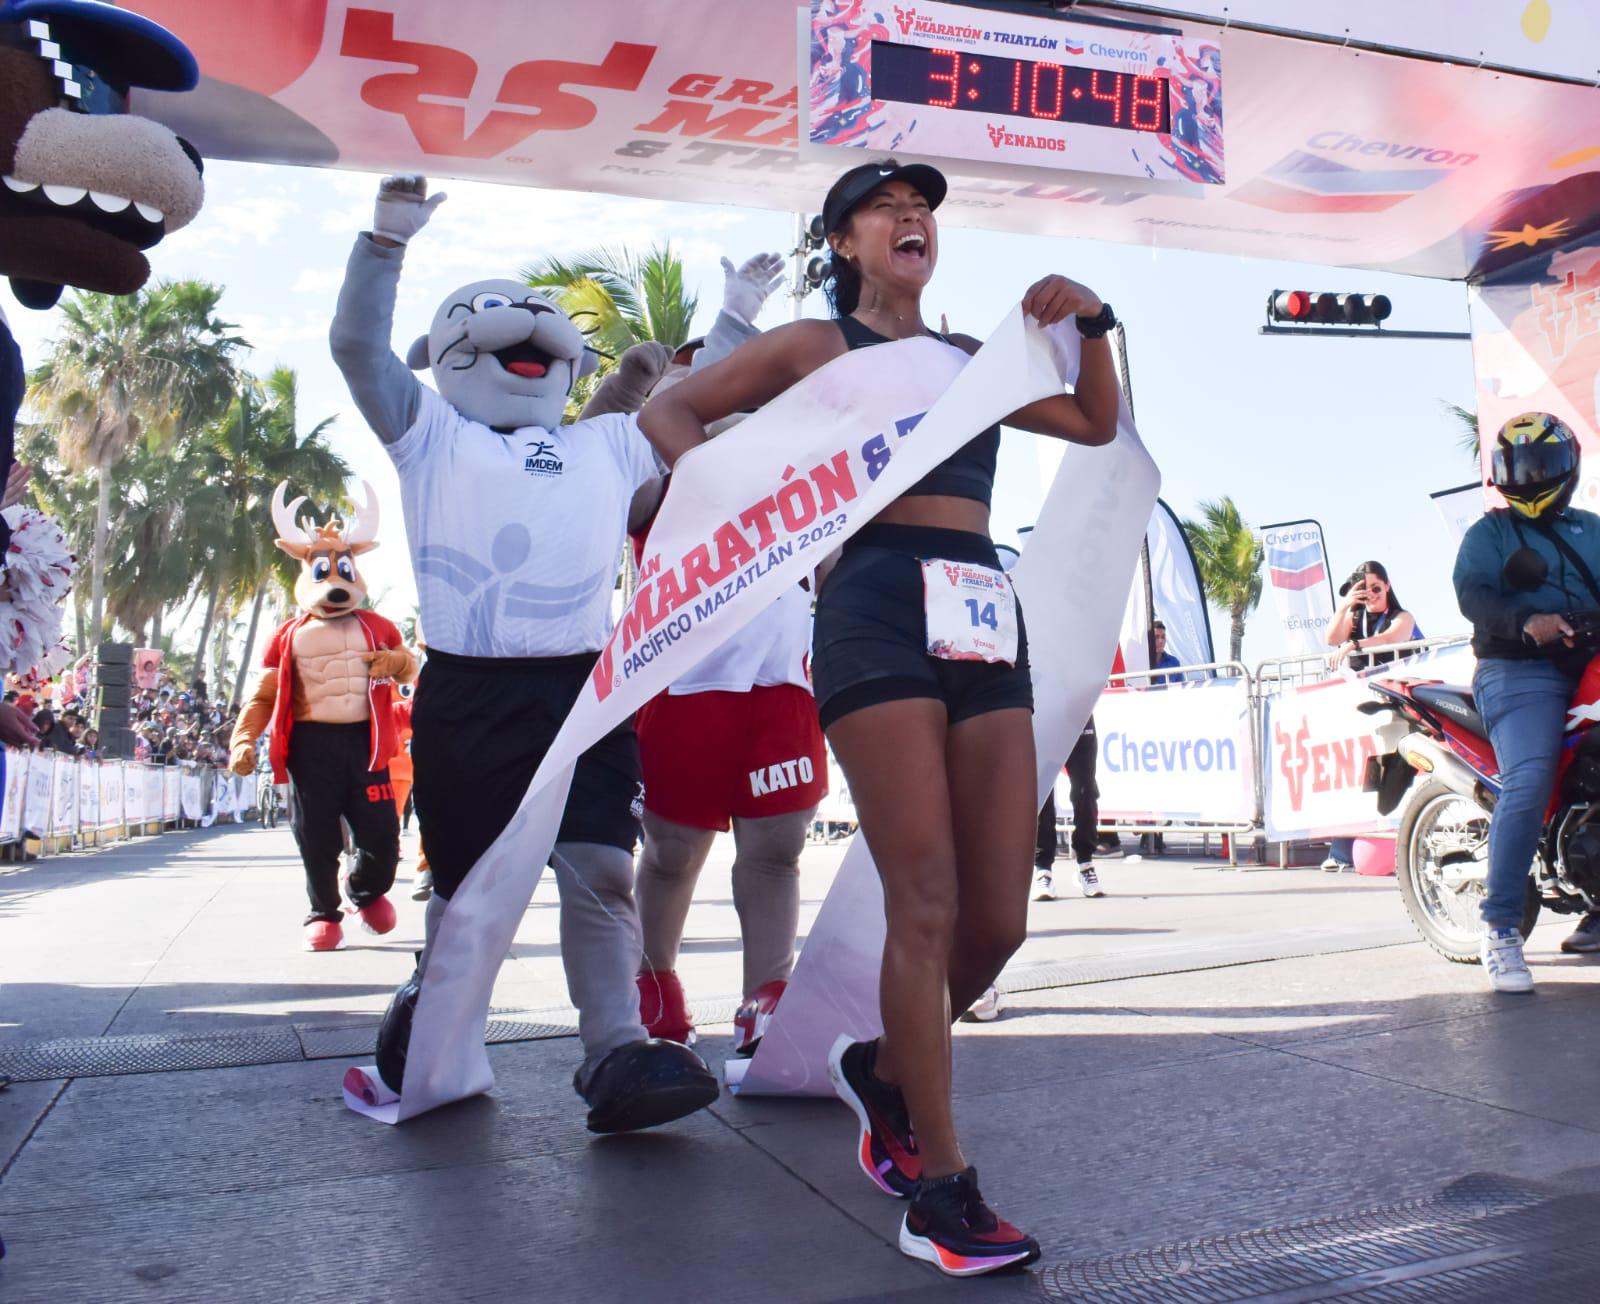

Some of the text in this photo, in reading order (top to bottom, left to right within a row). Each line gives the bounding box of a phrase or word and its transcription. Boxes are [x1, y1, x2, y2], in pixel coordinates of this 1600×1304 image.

[914, 21, 1058, 50] MARATÓN & TRIATLÓN
[1089, 42, 1148, 62] Chevron
[1306, 131, 1480, 166] Chevron
[525, 458, 563, 472] IMDEM
[622, 449, 858, 655] MARATÓN
[1265, 531, 1320, 546] Chevron
[623, 513, 848, 680] PACÍFICO MAZATLÁN 2023
[964, 598, 998, 632] 14
[1435, 698, 1469, 717] HONDA
[1102, 731, 1237, 773] Chevron
[748, 755, 814, 799] KATO
